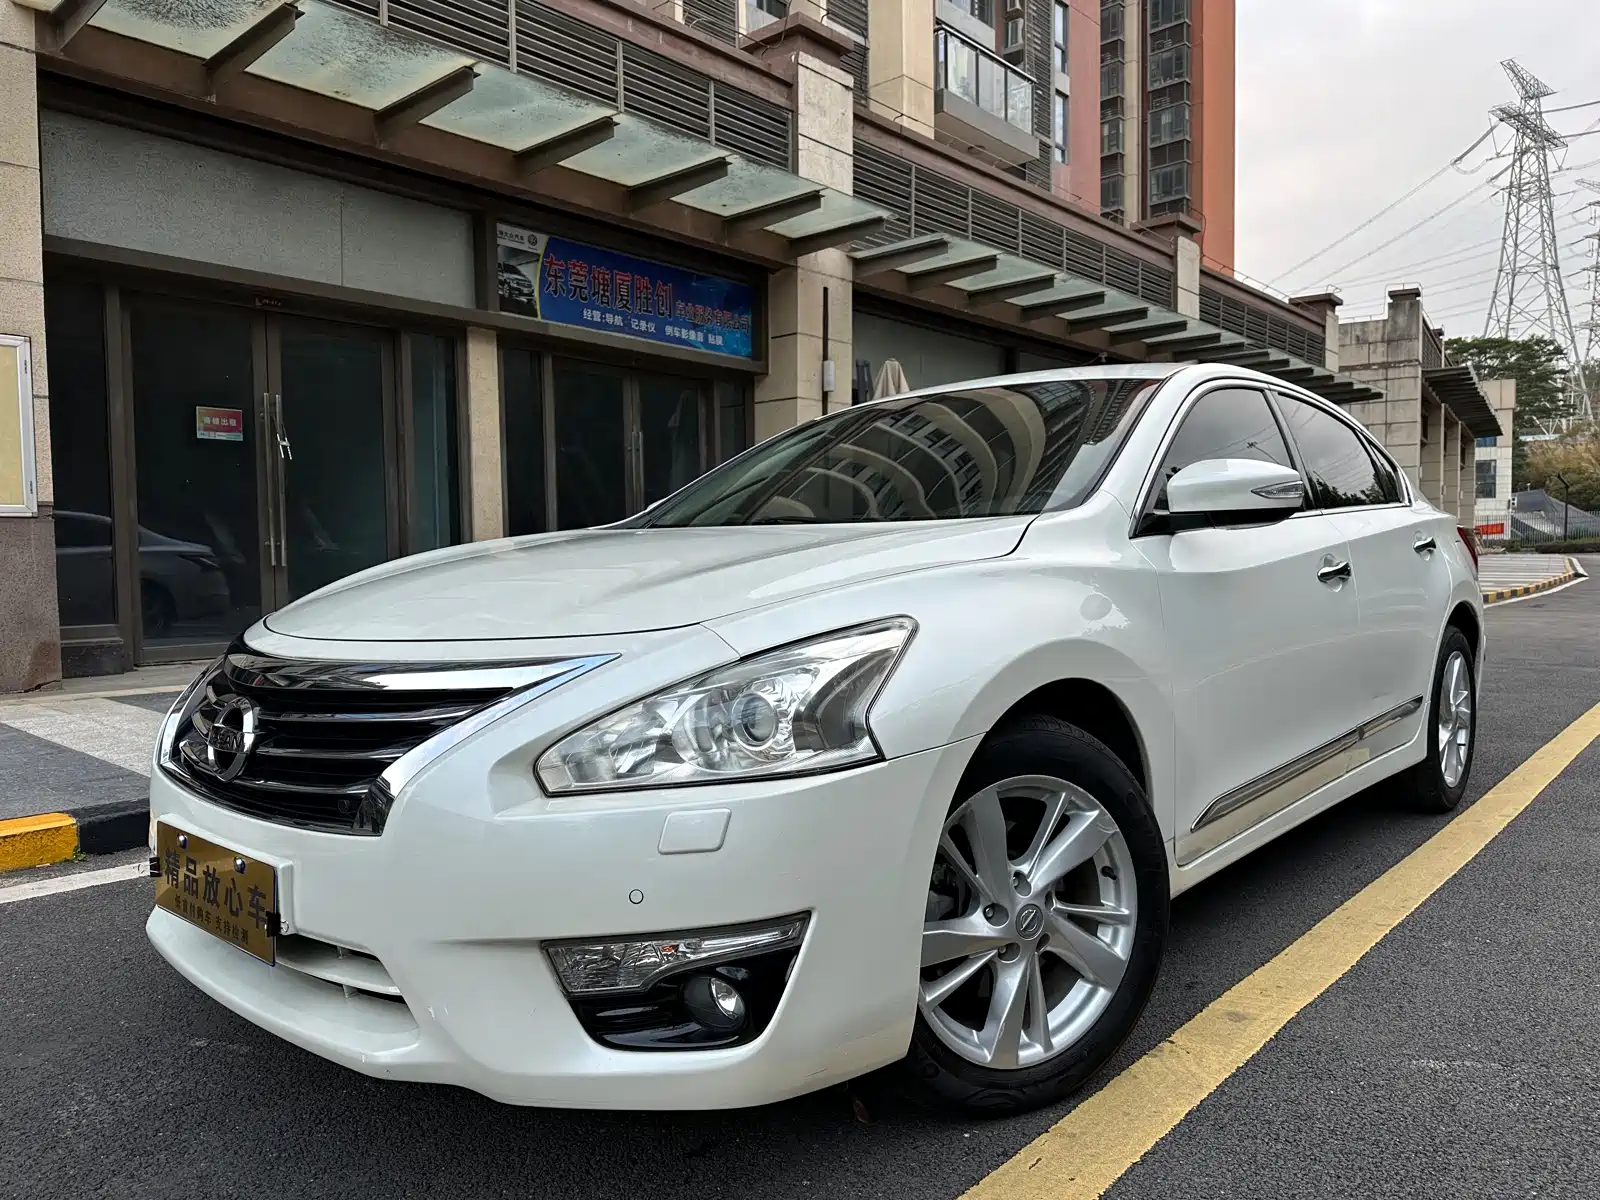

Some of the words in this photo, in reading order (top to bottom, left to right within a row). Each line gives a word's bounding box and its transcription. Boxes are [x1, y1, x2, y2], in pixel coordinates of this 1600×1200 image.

[543, 252, 673, 320] 东莞塘厦胜创
[631, 317, 656, 333] 记录仪
[165, 848, 267, 930] 精品放心车
